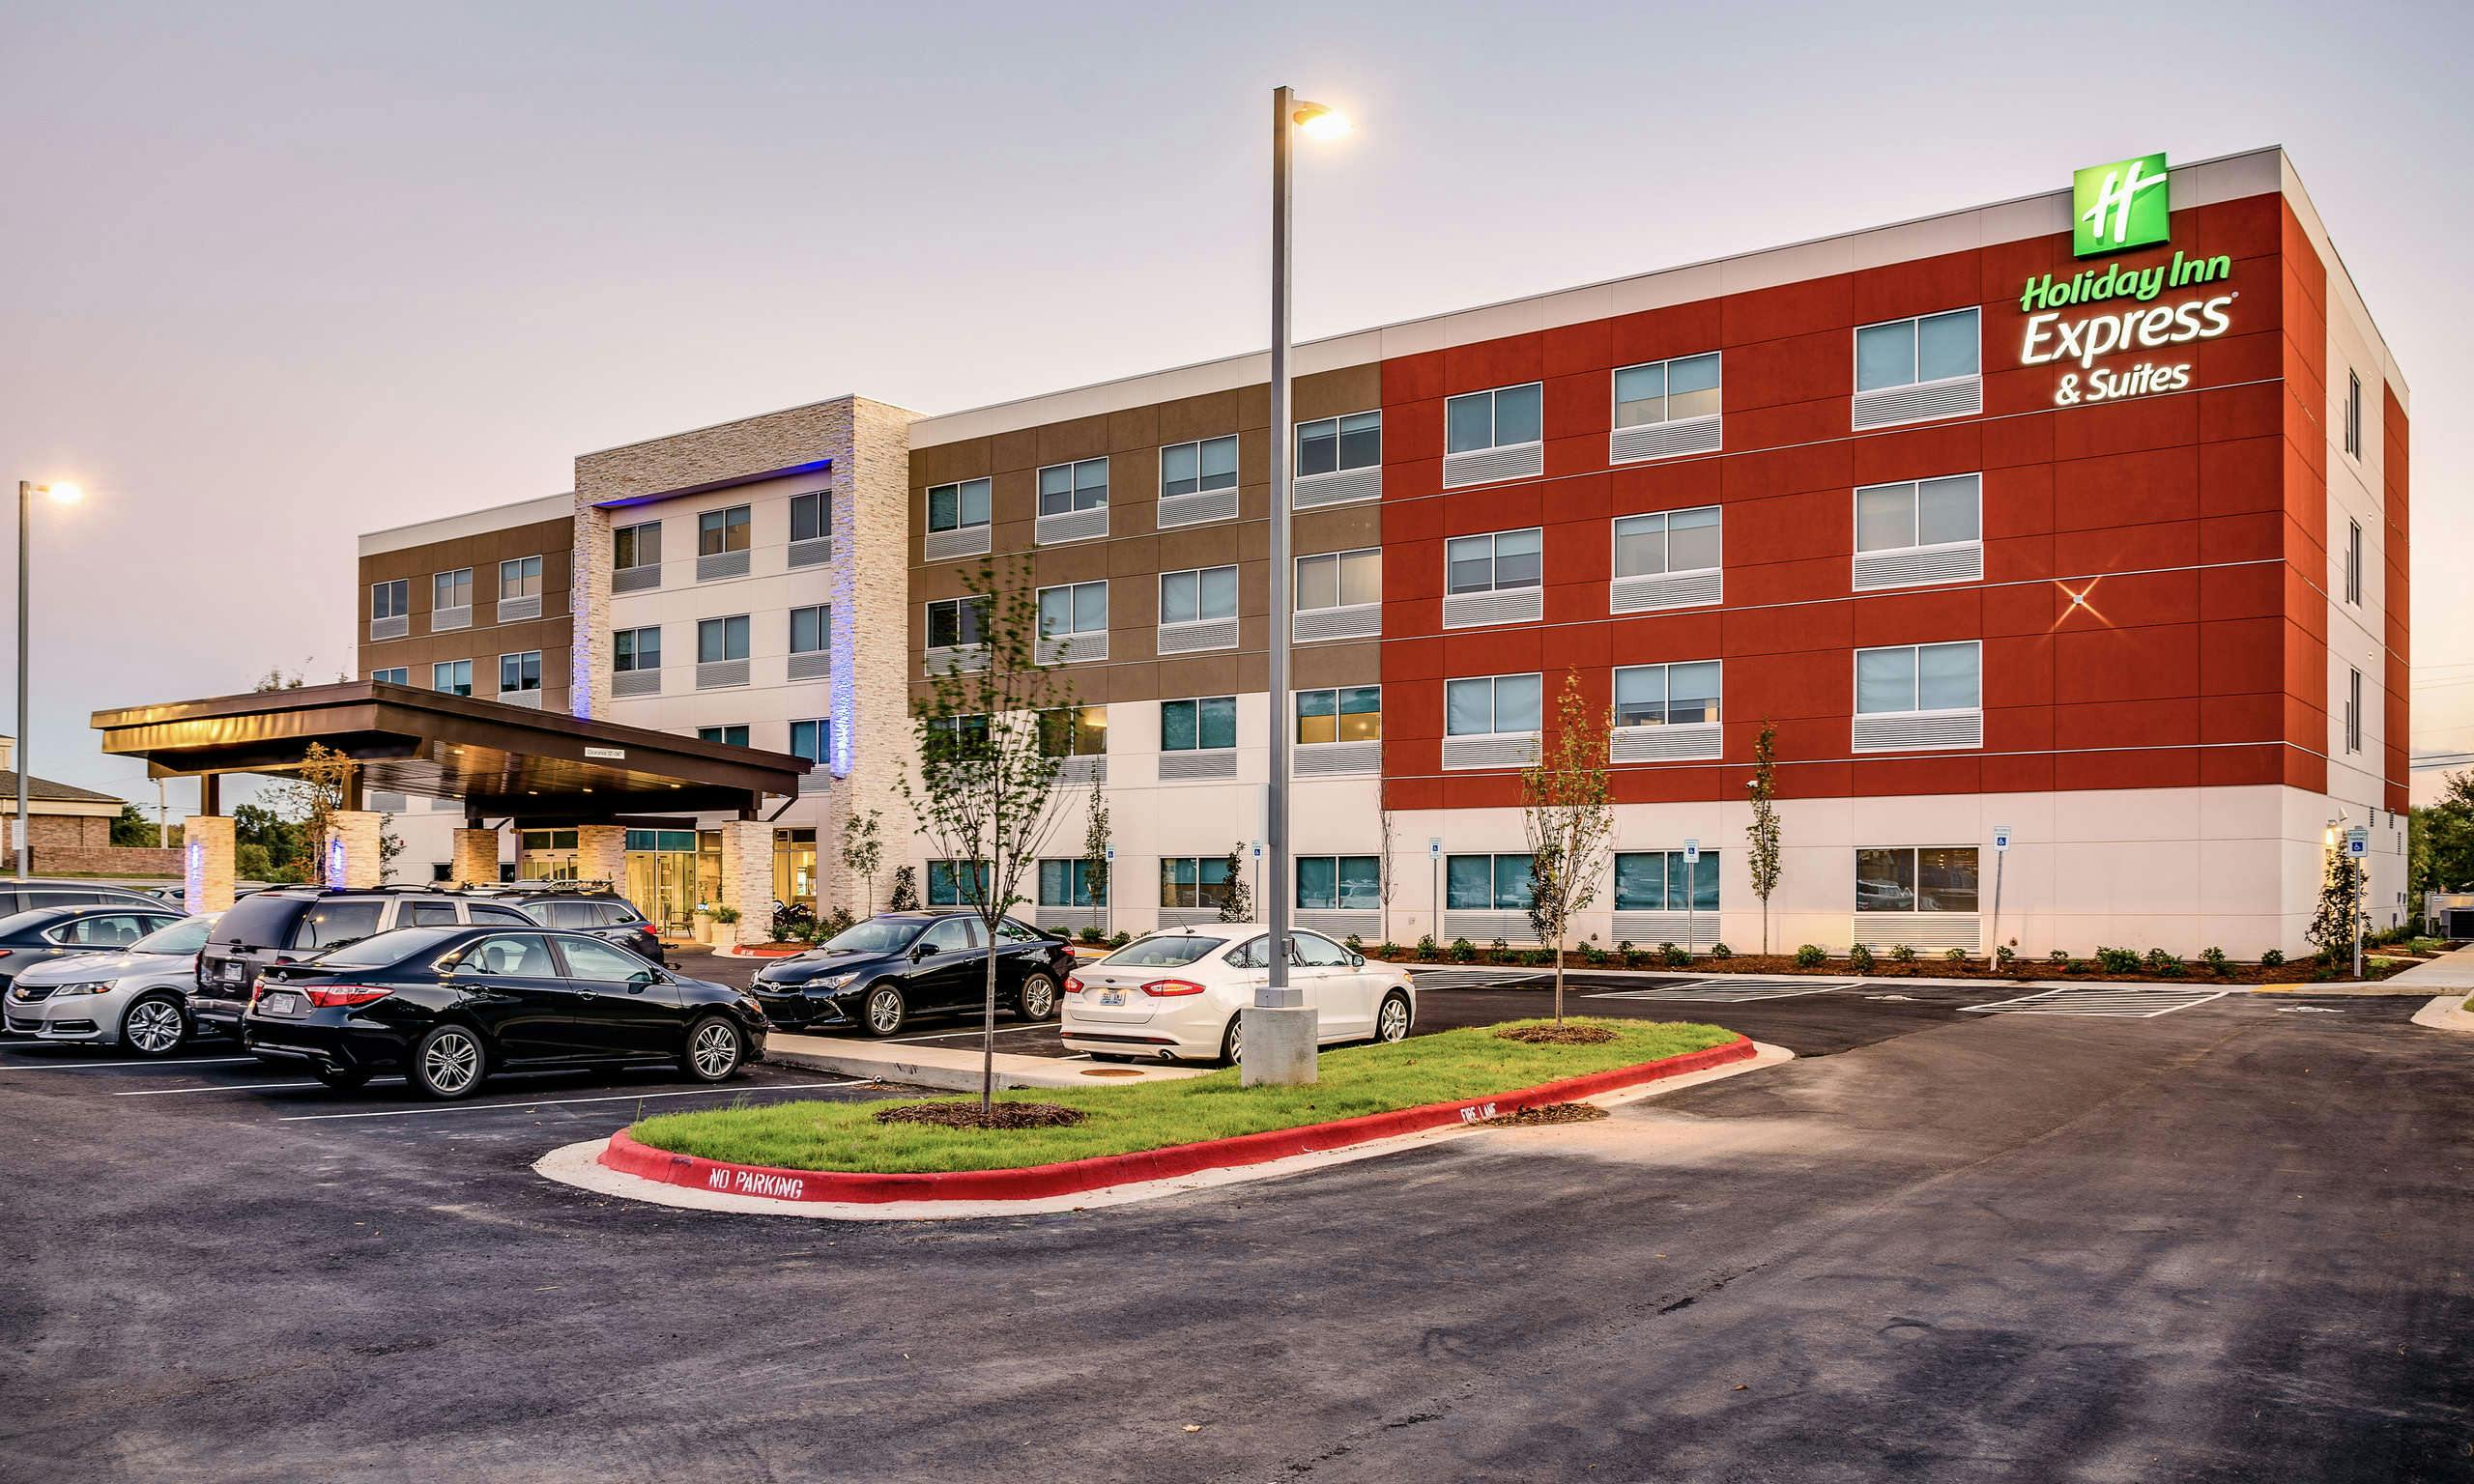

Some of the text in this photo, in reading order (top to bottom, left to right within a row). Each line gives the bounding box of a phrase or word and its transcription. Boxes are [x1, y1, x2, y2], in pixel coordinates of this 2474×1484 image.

[2020, 250, 2230, 312] Holiday Inn
[2021, 296, 2232, 369] Express
[2055, 363, 2191, 405] & Suites
[1460, 1102, 1497, 1123] FIRE LANE
[709, 1168, 803, 1199] NO PARKING
